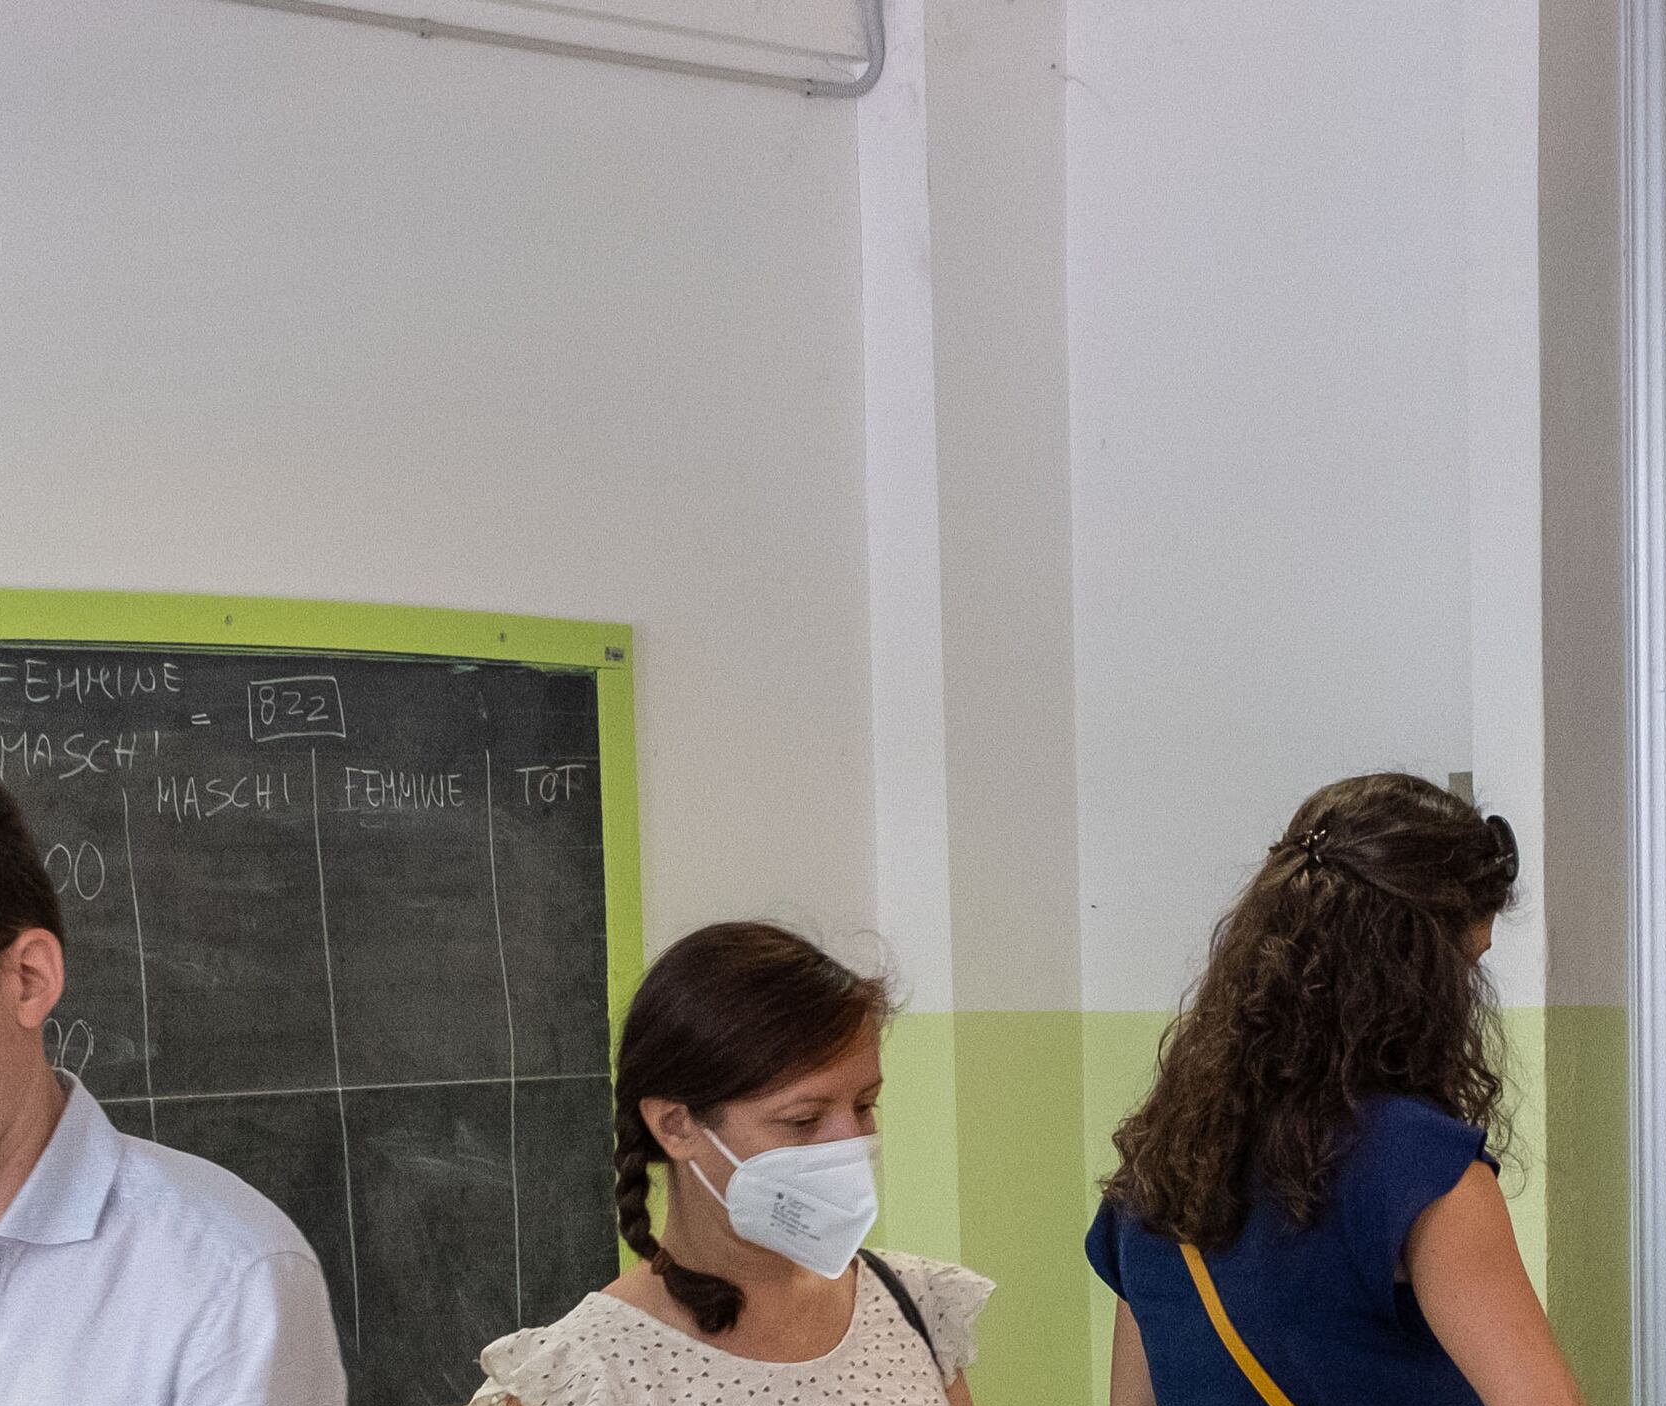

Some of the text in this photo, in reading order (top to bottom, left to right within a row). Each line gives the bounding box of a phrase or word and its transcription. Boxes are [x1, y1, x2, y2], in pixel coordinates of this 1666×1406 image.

[258, 685, 330, 726] 822
[156, 772, 292, 823] MASCHI
[514, 764, 587, 806] TOT
